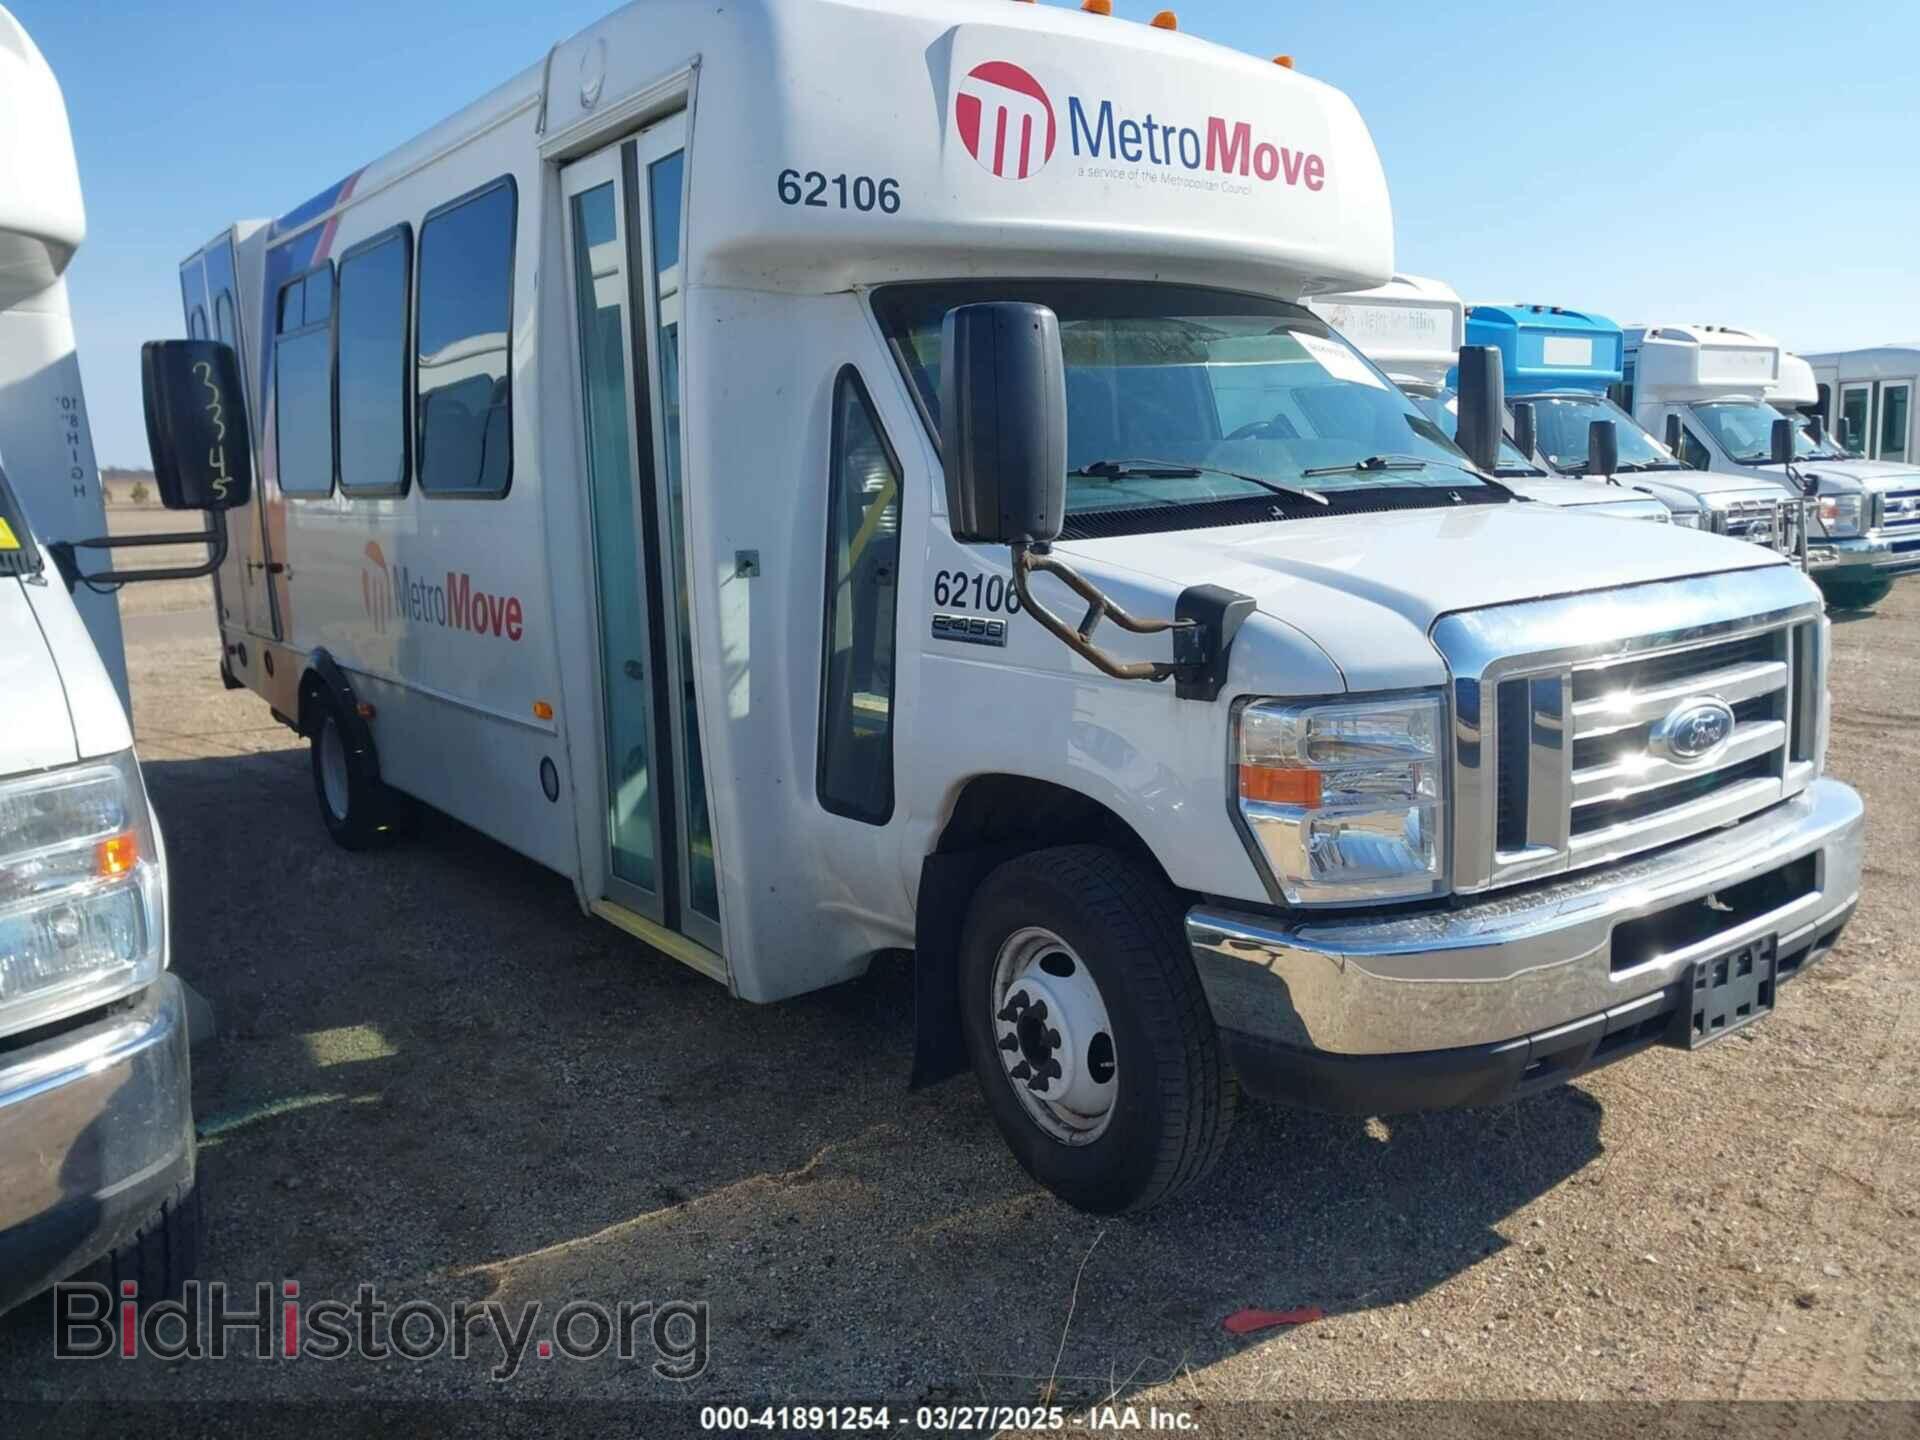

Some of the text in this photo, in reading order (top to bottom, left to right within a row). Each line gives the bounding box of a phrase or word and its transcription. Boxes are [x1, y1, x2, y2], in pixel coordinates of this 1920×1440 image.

[1069, 96, 1326, 191] MetroMove
[777, 169, 901, 214] 62106
[1077, 167, 1252, 196] a service of the Metropolitan Council
[393, 564, 523, 641] MetroMove
[934, 570, 1022, 614] 62106
